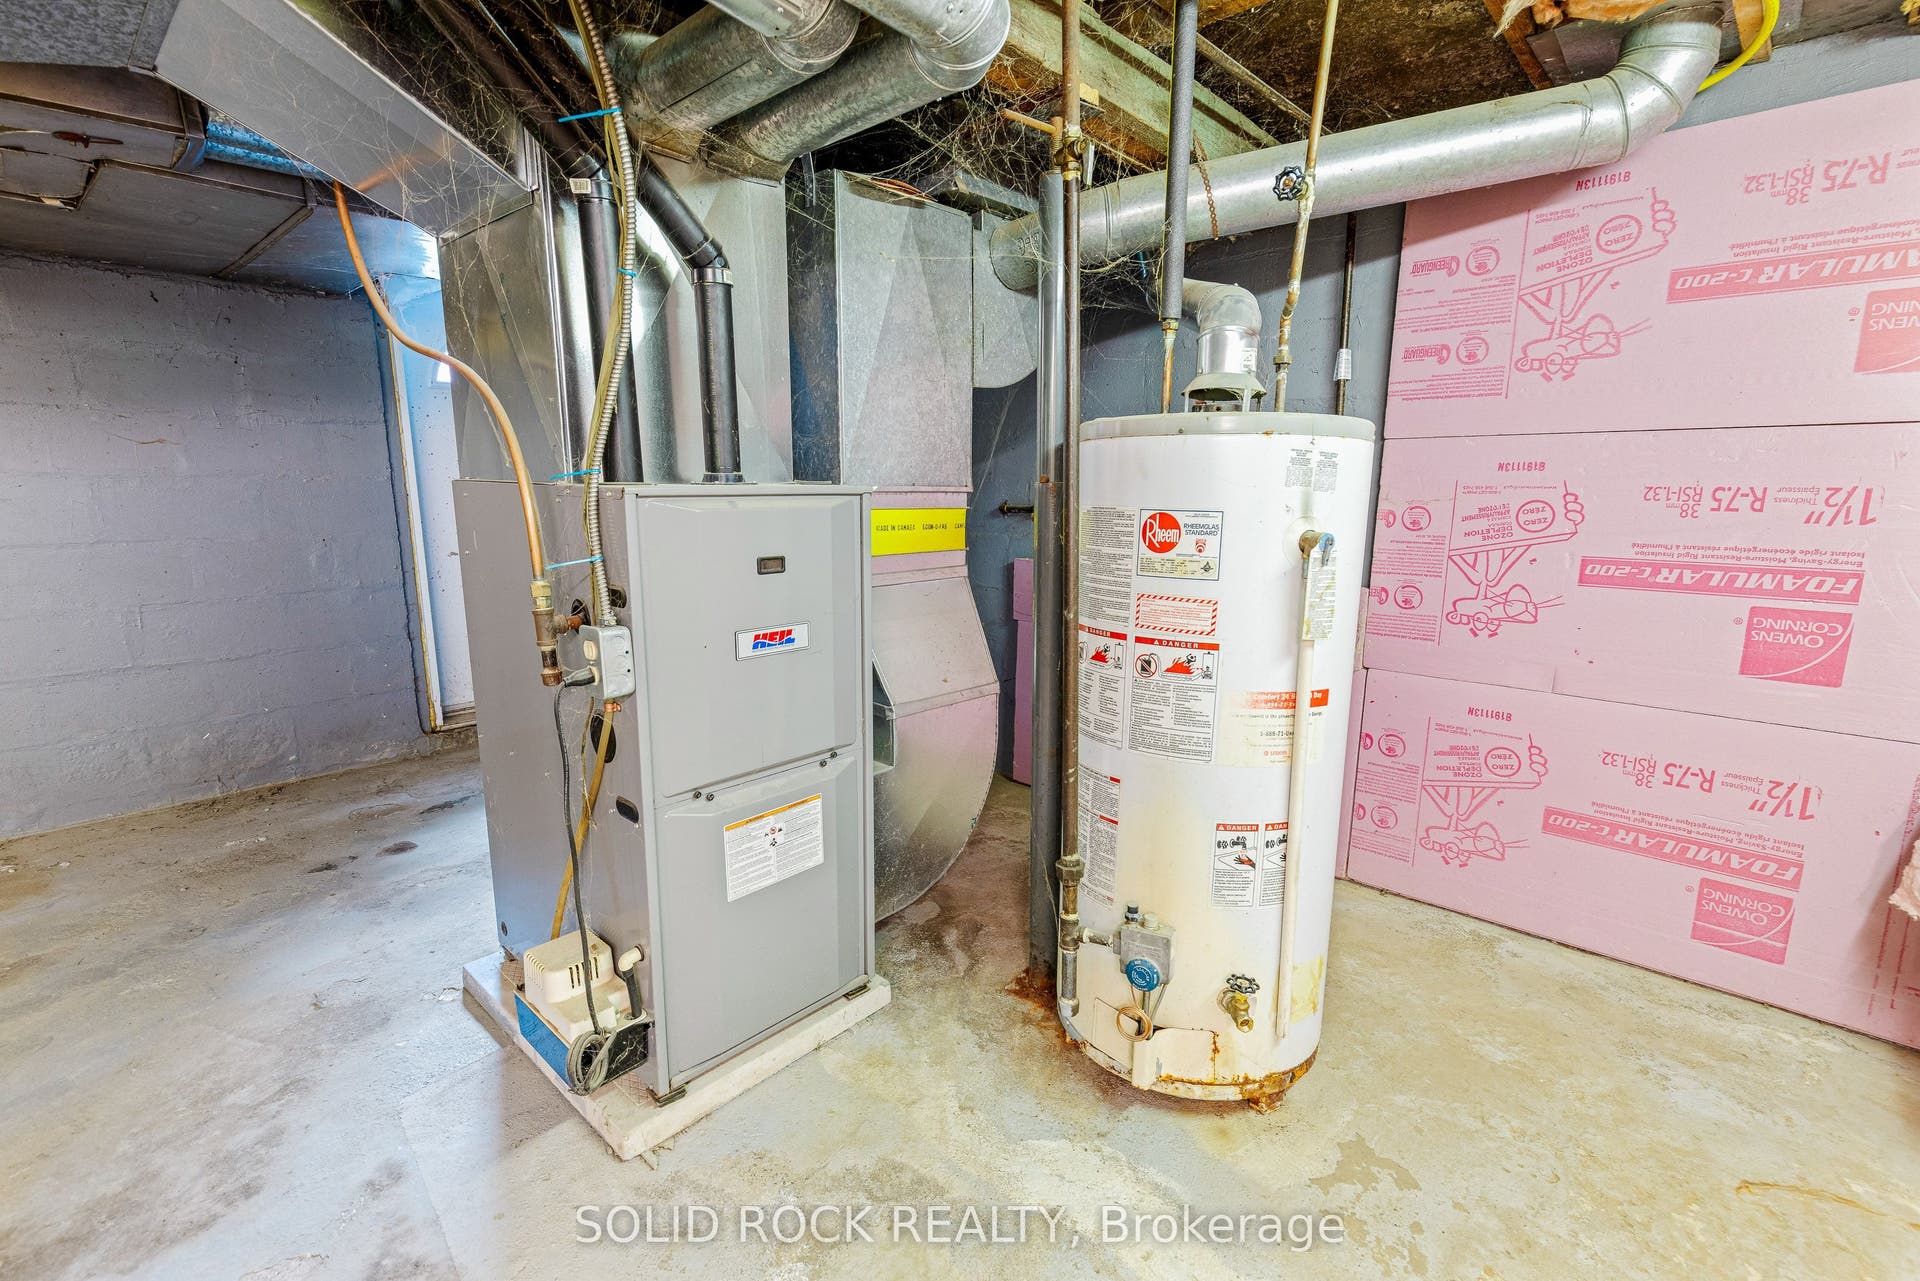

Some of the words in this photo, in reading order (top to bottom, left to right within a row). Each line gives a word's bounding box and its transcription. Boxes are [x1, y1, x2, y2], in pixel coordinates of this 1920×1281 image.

[1744, 165, 1815, 194] RSI-1.32
[1821, 152, 1891, 192] R-7.5
[1576, 171, 1631, 191] 8191113N
[1605, 233, 1633, 247] ZERO
[1810, 230, 1912, 248] Moisture-Resistant
[1732, 247, 1780, 258] Insulation
[1782, 244, 1808, 253] Rigid
[1536, 250, 1592, 272] DEPLETION
[1556, 257, 1593, 273] OZONE
[1675, 268, 1752, 290] C-200
[1498, 461, 1546, 472] 8191113N
[1643, 486, 1703, 503] RSI-1.32
[1777, 486, 1820, 497] Épaisseur
[1710, 486, 1768, 513] R-7.5
[1773, 497, 1818, 506] Thickness
[1523, 517, 1548, 526] ZERO
[1146, 513, 1180, 548] Rheem
[1464, 526, 1512, 538] DEPLETION
[1482, 532, 1513, 541] OZONE
[1634, 550, 1674, 559] Insulation
[1682, 543, 1721, 552] résistant
[1722, 545, 1797, 557] écoénergétique
[1799, 549, 1828, 557] rigide
[1830, 551, 1865, 559] Isolant
[1675, 551, 1698, 561] Rigid
[1700, 552, 1787, 565] Moisture-Resistant
[1789, 556, 1863, 568] Energy-Saving,
[1585, 564, 1651, 579] C-200
[1753, 617, 1844, 637] CORNING
[752, 629, 796, 650] HEIL
[1162, 640, 1199, 649] DANGER
[1751, 630, 1824, 649] OWENS
[1468, 706, 1512, 721] 8191113N
[1491, 763, 1515, 771] ZERO
[1601, 751, 1657, 775] RSI-1.32
[1662, 761, 1716, 793] R-7.5
[1723, 772, 1764, 786] Épaisseur
[1721, 780, 1761, 795] Thickness
[1593, 808, 1630, 823] Insulation
[1631, 816, 1652, 826] Rigid
[1638, 810, 1674, 822] résistant
[1549, 814, 1610, 837] C-200
[1653, 819, 1734, 845] Moisture-Resistant
[1675, 817, 1743, 835] écoénergétique
[1744, 831, 1771, 842] rigide
[1773, 838, 1805, 849] Isolant
[1735, 838, 1804, 859] Energy-Saving,
[1703, 888, 1786, 918] CORNING
[1701, 900, 1768, 926] OWENS
